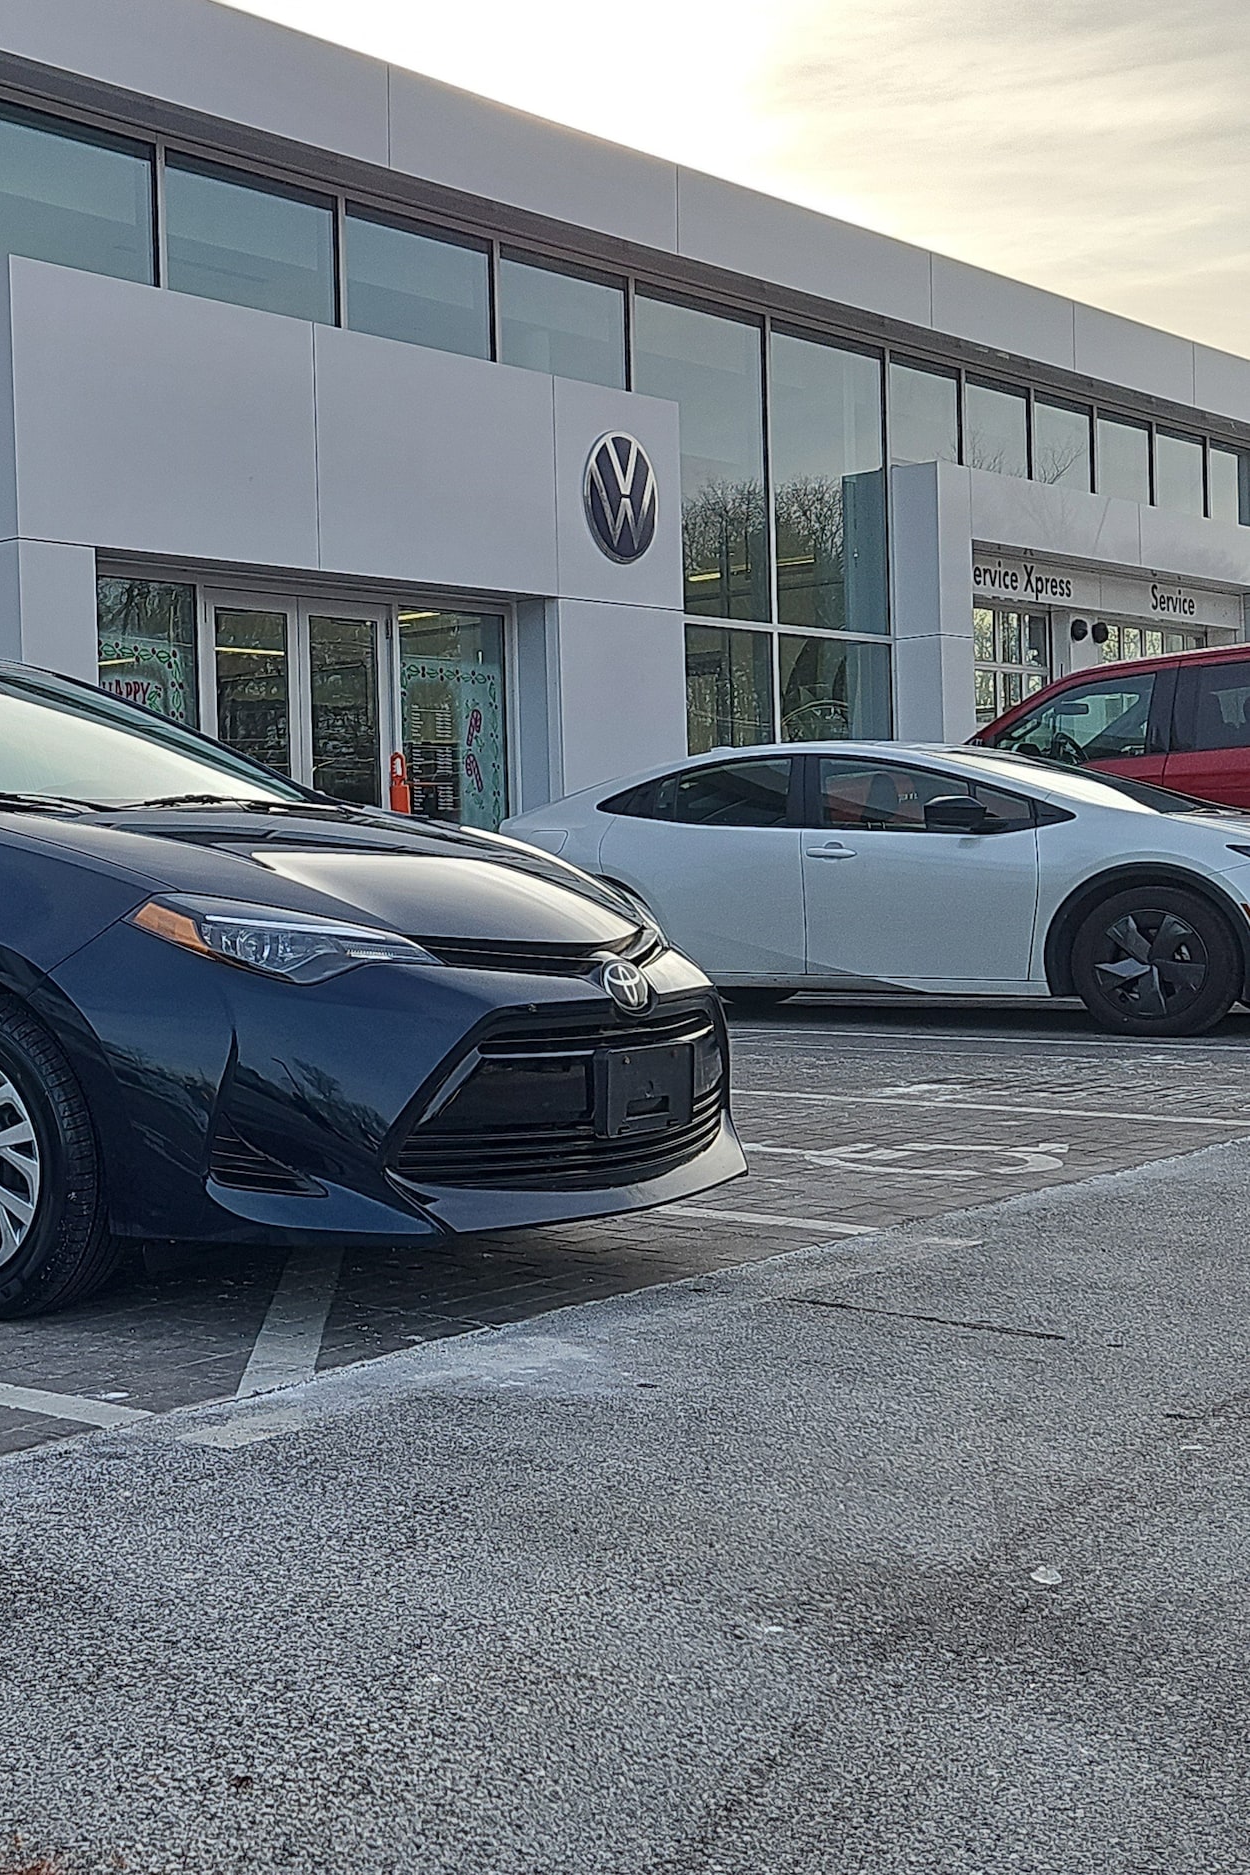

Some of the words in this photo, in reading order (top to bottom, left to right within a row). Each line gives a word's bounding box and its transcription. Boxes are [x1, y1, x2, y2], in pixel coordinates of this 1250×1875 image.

[586, 432, 657, 558] VW
[973, 560, 1019, 591] ervice
[1023, 564, 1072, 601] Xpress
[1151, 584, 1195, 615] Service
